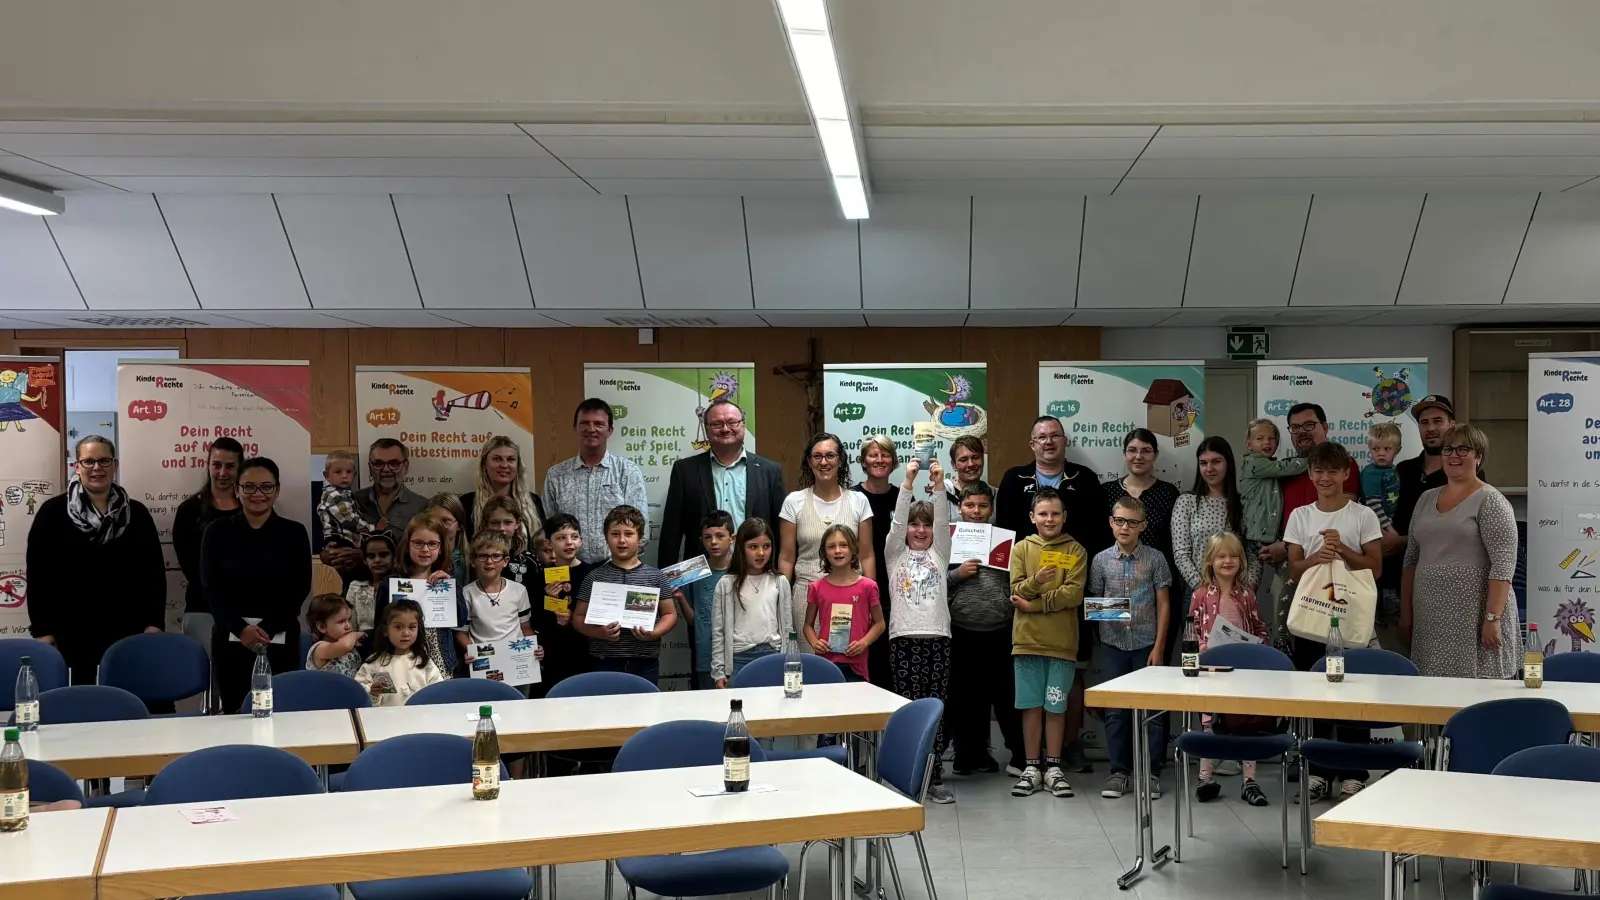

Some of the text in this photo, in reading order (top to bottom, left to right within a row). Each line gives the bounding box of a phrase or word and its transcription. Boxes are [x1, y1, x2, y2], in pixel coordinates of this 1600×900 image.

[1268, 402, 1284, 410] Art.
[1540, 399, 1570, 408] Art. 28
[614, 408, 622, 416] 31
[1073, 422, 1136, 432] Dein Recht
[1340, 420, 1374, 431] Recht
[180, 426, 252, 437] Dein Recht
[621, 426, 686, 436] Dein Recht
[862, 426, 886, 436] Dein
[400, 432, 492, 442] Dein Recht auf
[1066, 436, 1124, 447] uf Privatl
[174, 441, 198, 452] auf
[626, 440, 682, 454] auf Spiel,
[842, 438, 862, 450] auf
[162, 457, 186, 468] und
[648, 455, 658, 466] &
[1550, 480, 1570, 488] darfst
[1582, 480, 1591, 488] die
[145, 492, 154, 500] Du
[158, 492, 178, 500] darfst
[1554, 585, 1560, 593] du
[1300, 596, 1331, 608] STADTWERKE
